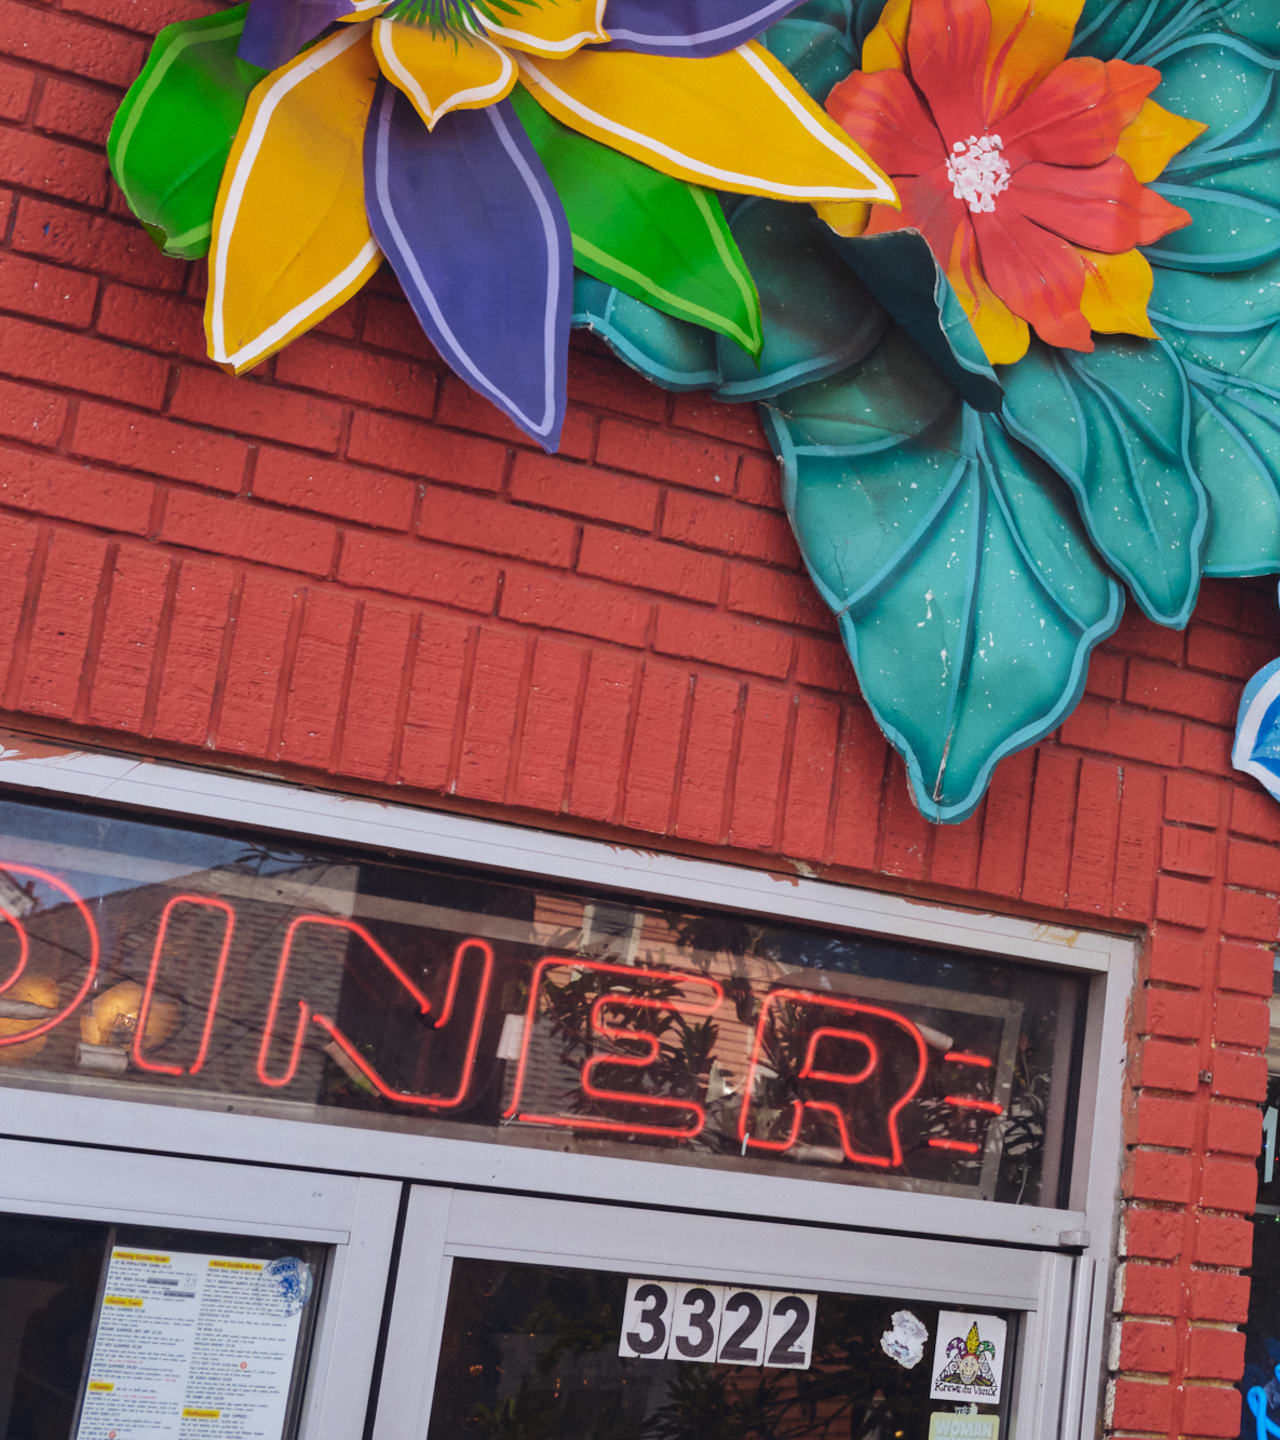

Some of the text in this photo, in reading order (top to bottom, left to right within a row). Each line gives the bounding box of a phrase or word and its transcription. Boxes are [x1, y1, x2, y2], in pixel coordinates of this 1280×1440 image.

[626, 1284, 812, 1366] 3322
[934, 1381, 961, 1394] Krewe
[962, 1385, 972, 1394] du
[954, 1405, 971, 1415] yelp
[934, 1419, 994, 1438] WOMAN
